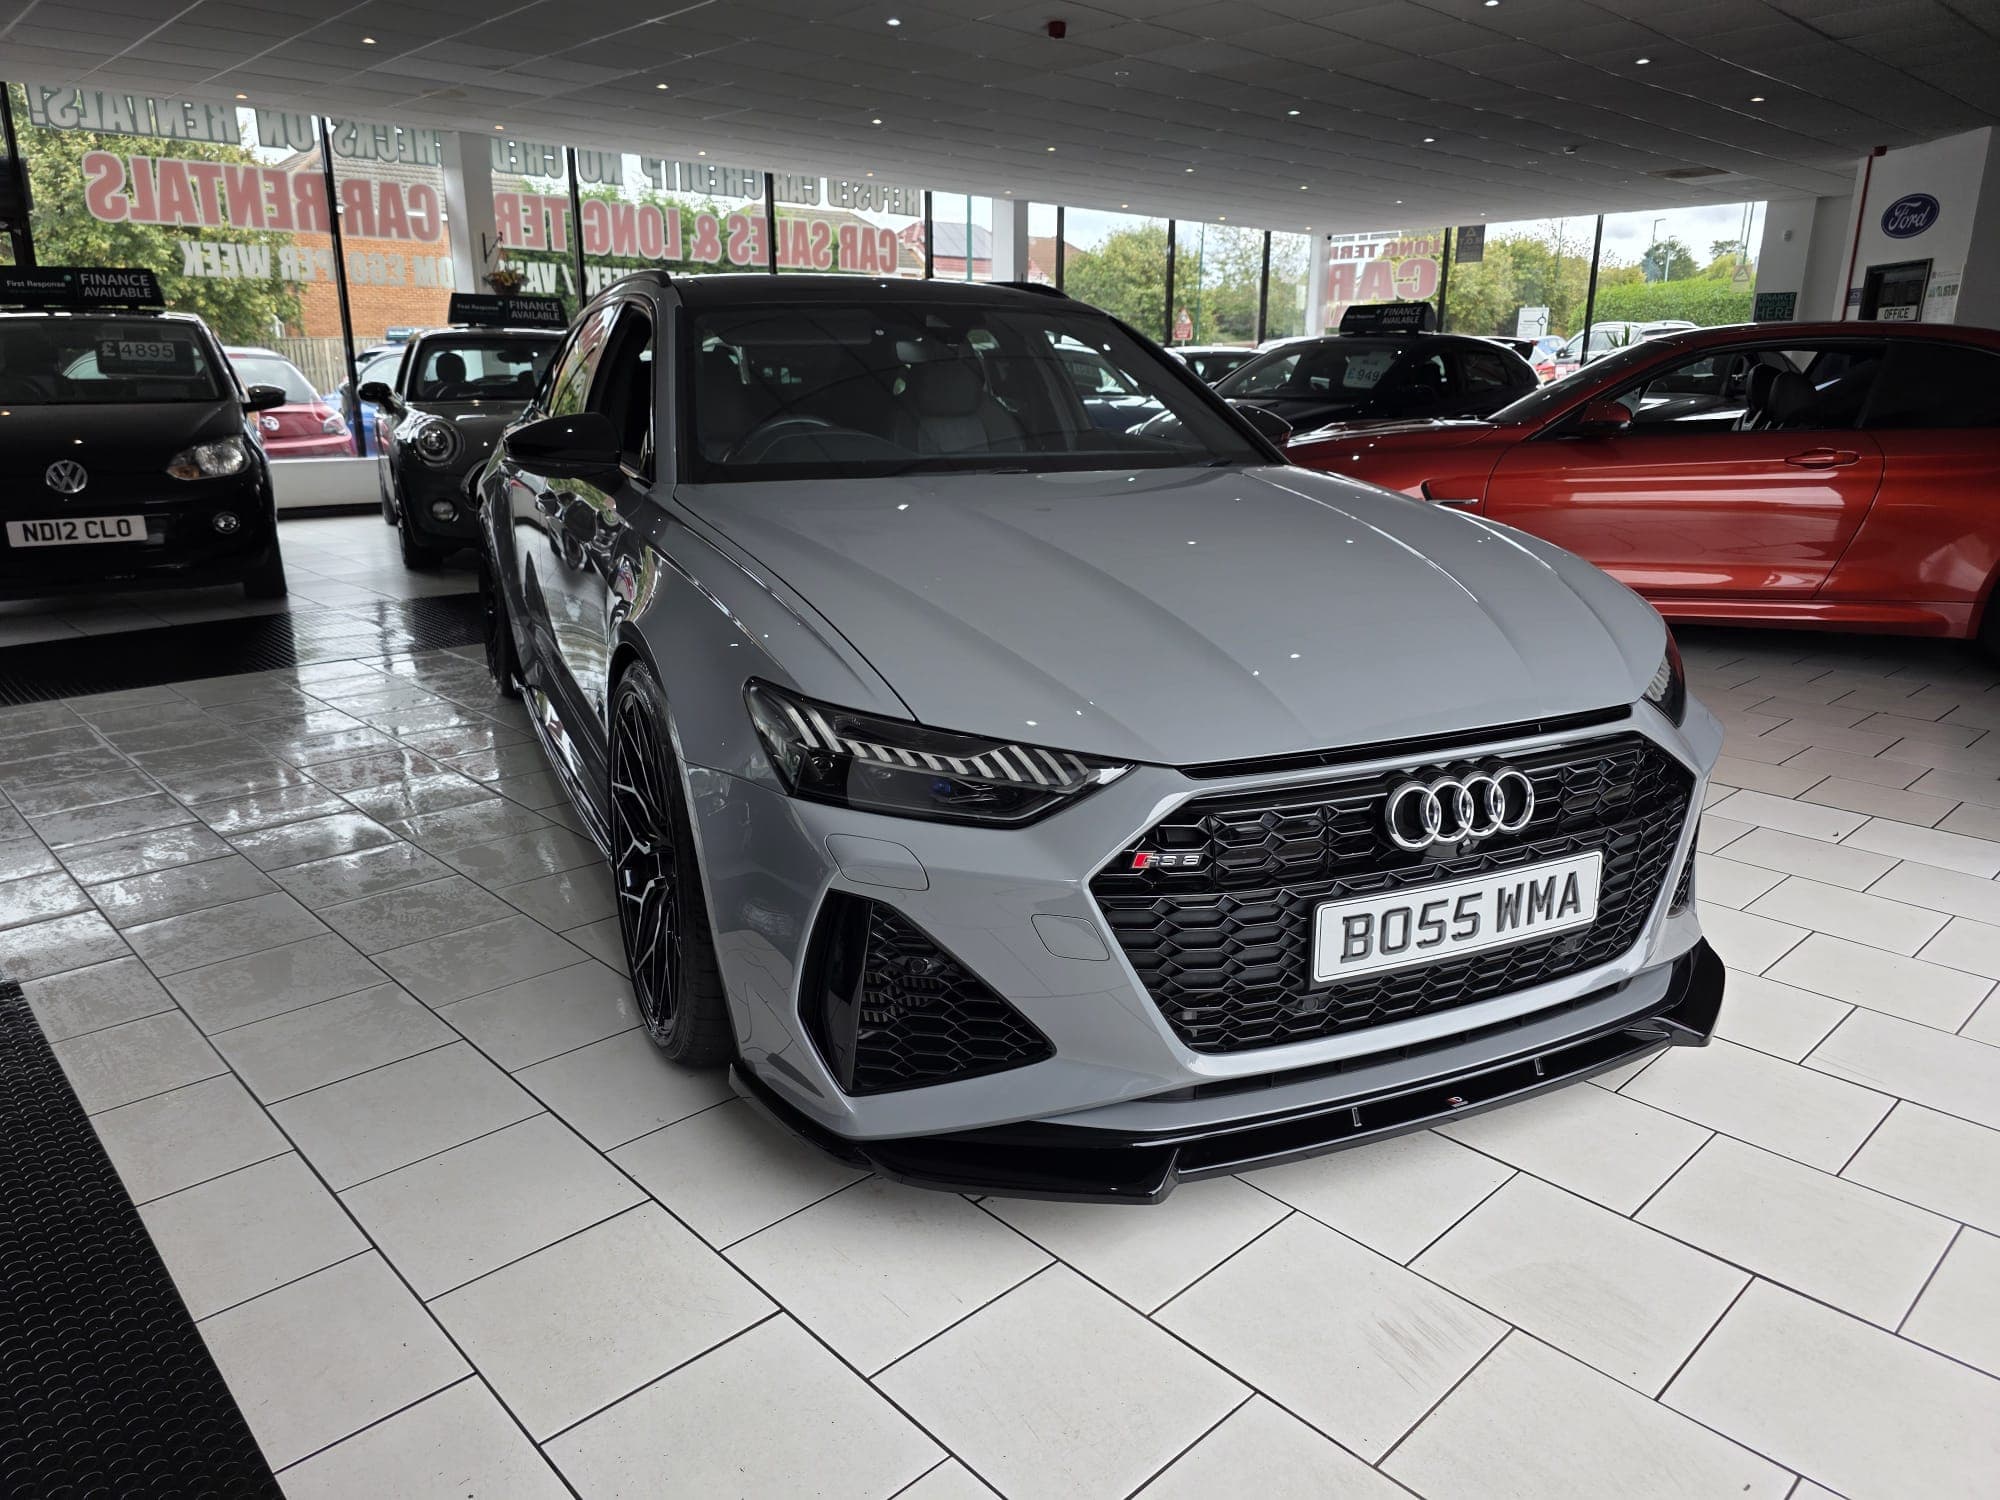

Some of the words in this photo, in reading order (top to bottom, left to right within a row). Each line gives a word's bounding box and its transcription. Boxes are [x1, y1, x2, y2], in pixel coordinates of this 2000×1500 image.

[1888, 201, 1929, 231] Ford
[6, 280, 25, 288] First
[26, 280, 66, 290] Response
[80, 273, 150, 287] FINANCE
[84, 287, 153, 298] AVAILABLE
[509, 300, 559, 312] FINANCE
[1383, 306, 1424, 316] FINANCE
[511, 311, 561, 321] AVAILABLE
[1756, 306, 1793, 320] HERE
[1883, 307, 1910, 320] OFFICE
[1382, 316, 1420, 325] AVAILABLE
[22, 521, 79, 543] ND12
[84, 518, 132, 540] CLO
[1496, 870, 1583, 935] WMA
